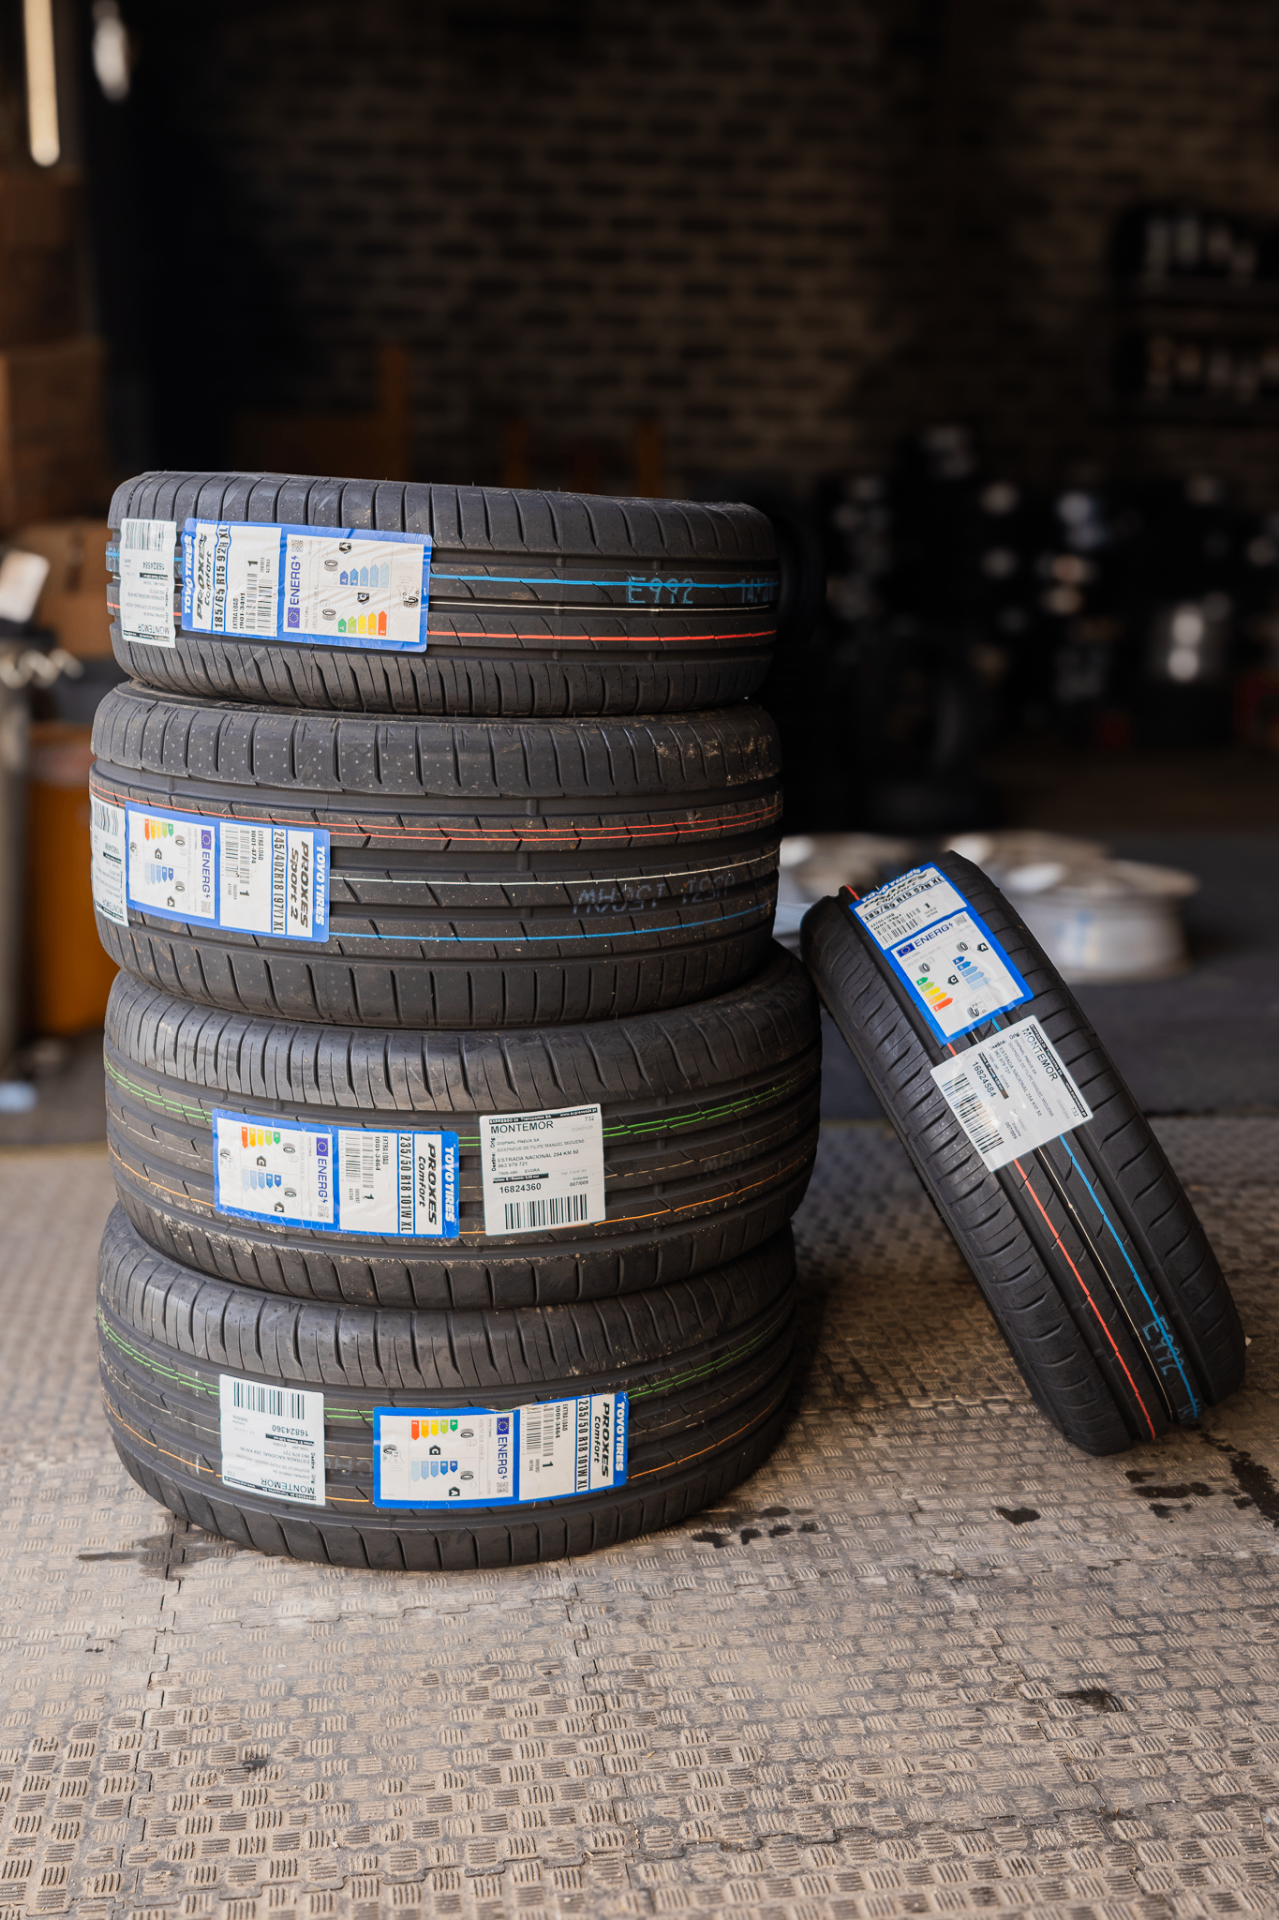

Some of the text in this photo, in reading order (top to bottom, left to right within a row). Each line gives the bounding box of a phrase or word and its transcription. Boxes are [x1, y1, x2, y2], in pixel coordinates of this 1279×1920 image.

[184, 577, 192, 614] TOYO
[197, 533, 207, 620] PROXES
[215, 527, 229, 628] 185/65 R15 92H XL
[290, 562, 300, 605] ENERG
[627, 577, 693, 603] E992
[137, 623, 169, 634] MONTEMOR
[202, 851, 210, 893] ENERG
[274, 832, 284, 890] 245/40ZR18
[932, 875, 943, 885] XL
[290, 848, 299, 920] Sport 2
[300, 841, 309, 928] PROXES
[316, 846, 325, 925] TOYO TIRES
[859, 867, 921, 903] TOYO TIRES
[923, 901, 931, 910] 1
[274, 921, 283, 931] XL
[912, 923, 950, 947] ENERG
[970, 1059, 997, 1098] 16824584
[998, 1046, 1014, 1069] ESTRADA
[1011, 1068, 1028, 1093] NACIONAL
[1021, 1026, 1079, 1117] MONTEMOR 732
[491, 1120, 554, 1134] MONTEMOR
[318, 1158, 327, 1198] ENERG
[498, 1155, 524, 1163] ESTRADA
[400, 1136, 411, 1231] 235/50 R18 101W XL
[418, 1156, 426, 1208] Comfort
[428, 1143, 437, 1225] PROXES
[445, 1147, 454, 1223] TOYO TIRES
[499, 1183, 542, 1194] 16824360
[272, 1424, 309, 1437] 16824360
[577, 1400, 588, 1490] 235/50 R18 101W XL
[616, 1402, 624, 1471] TOYO TIRES
[262, 1452, 286, 1460] NACIONAL
[287, 1456, 310, 1464] ESTRADA
[498, 1437, 507, 1474] ENERG
[260, 1478, 315, 1494] MONTEMOR
